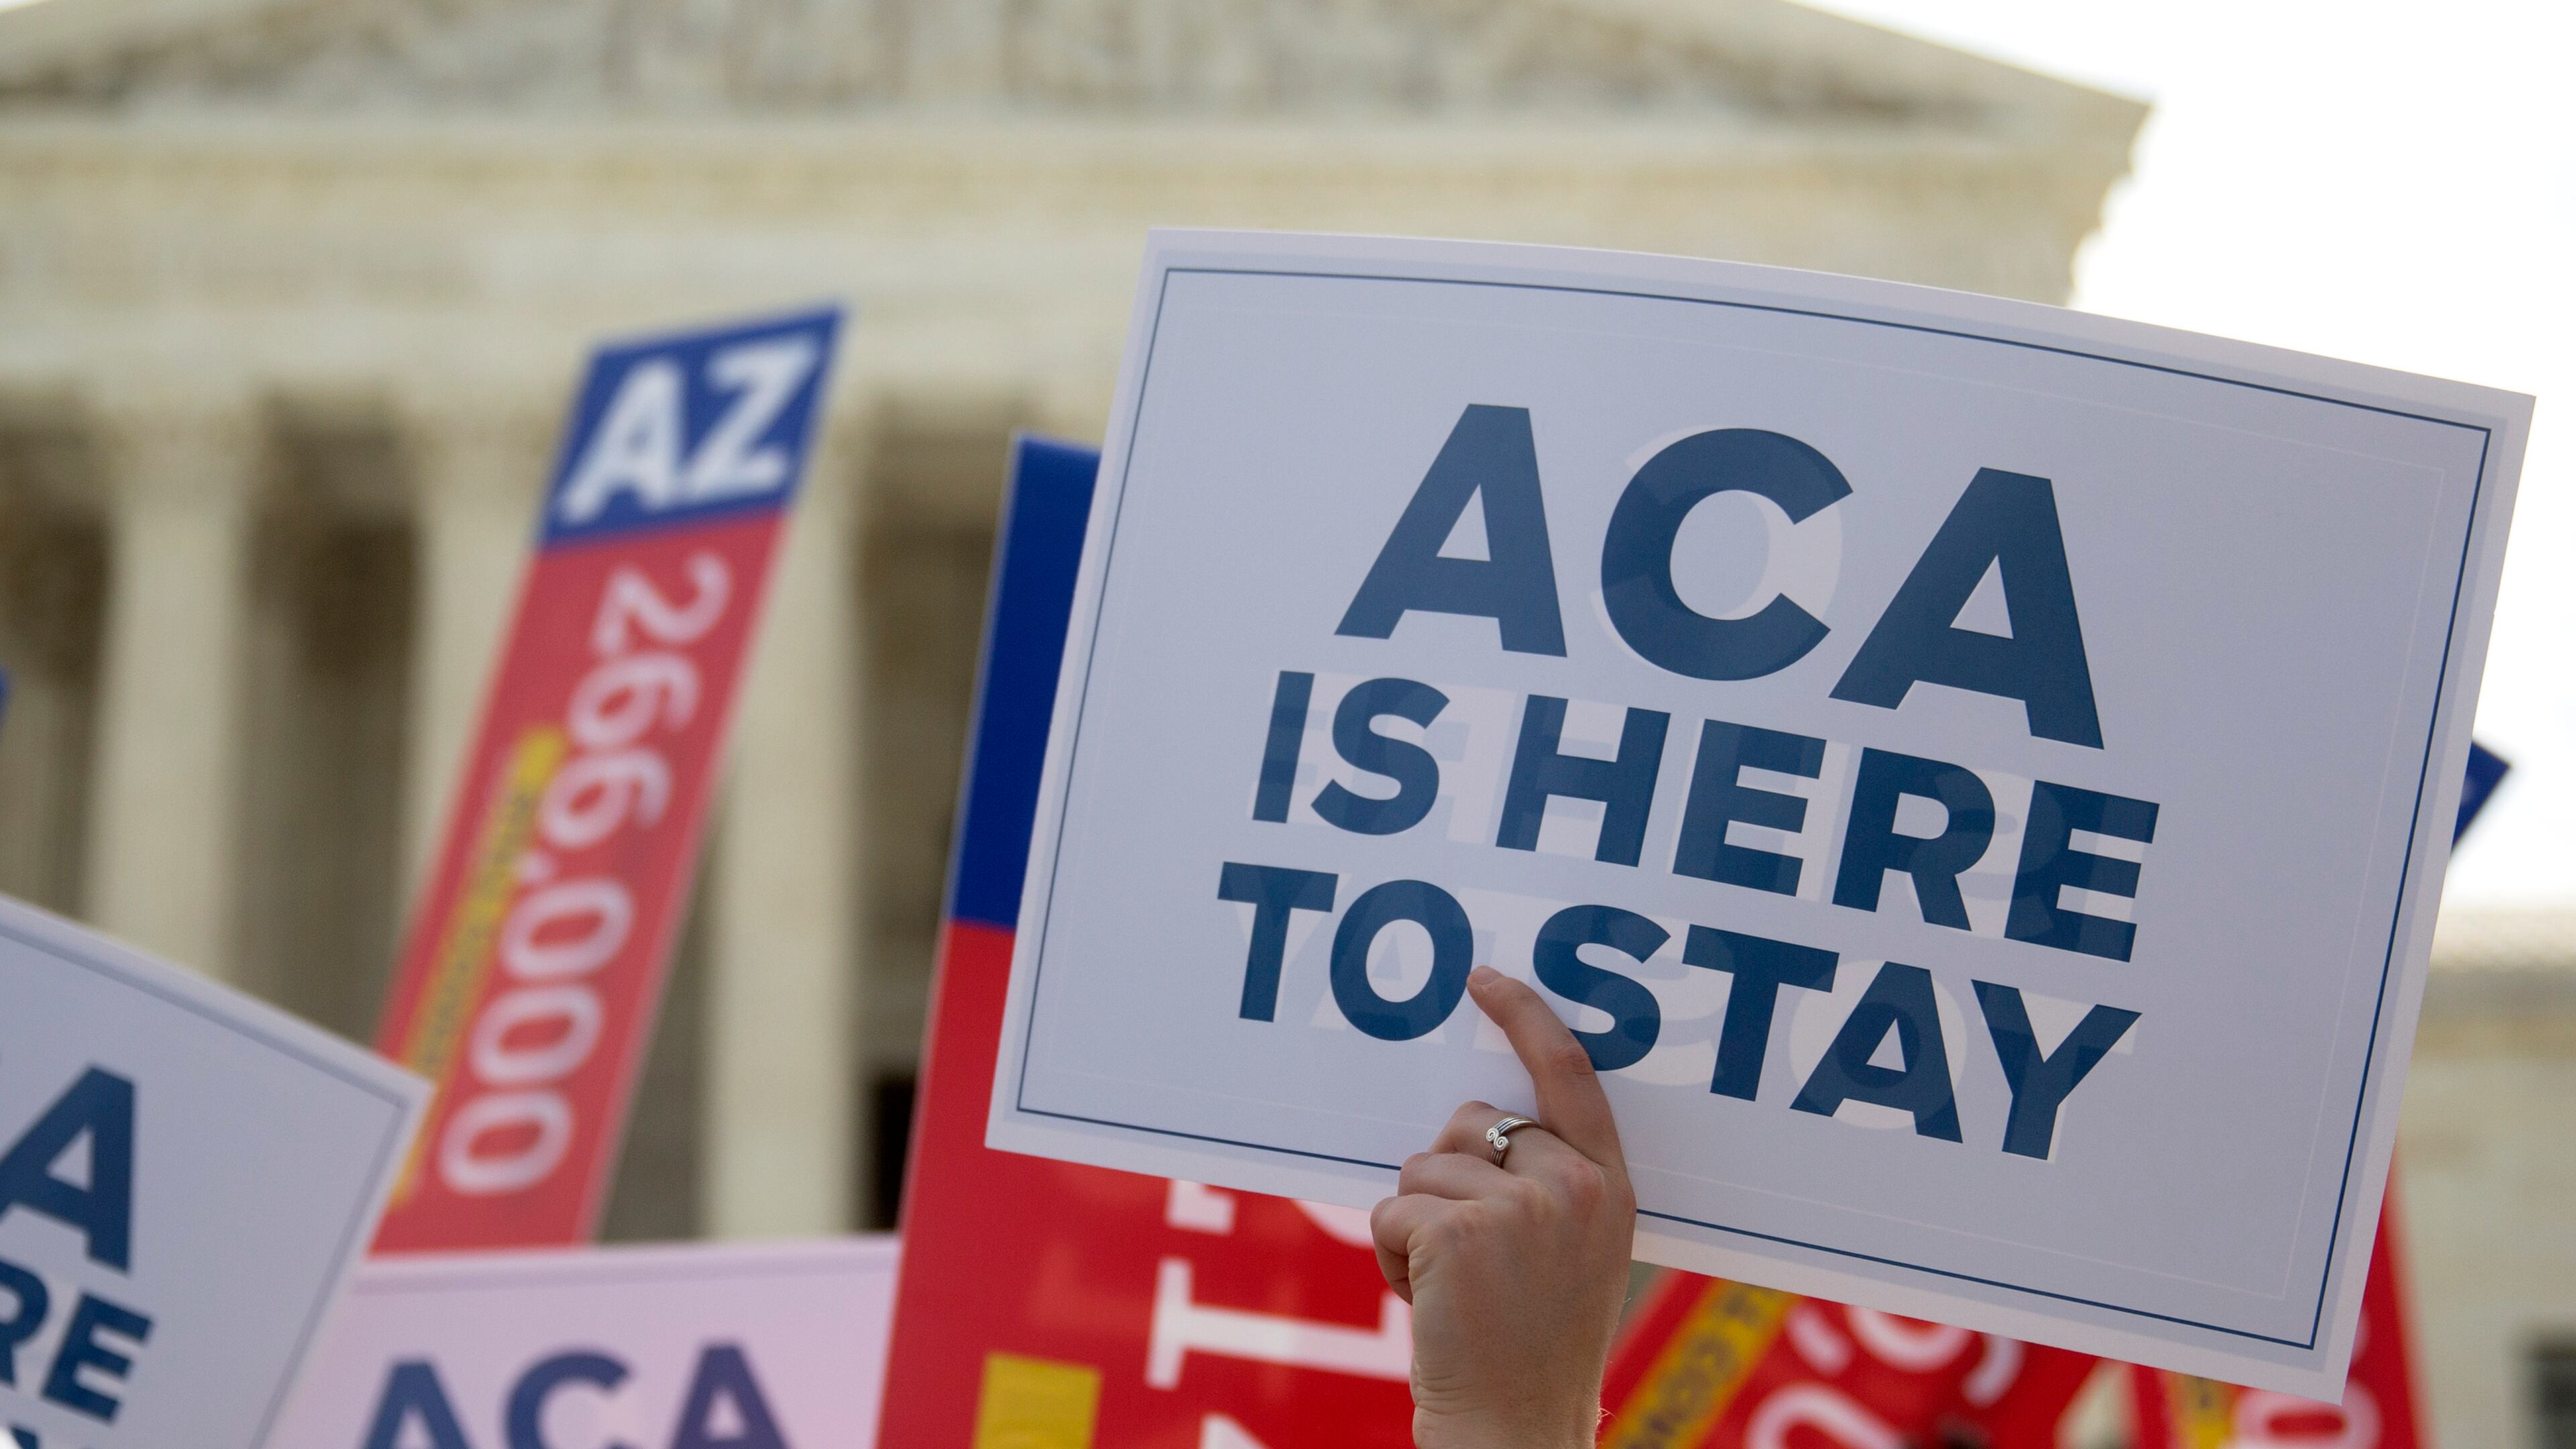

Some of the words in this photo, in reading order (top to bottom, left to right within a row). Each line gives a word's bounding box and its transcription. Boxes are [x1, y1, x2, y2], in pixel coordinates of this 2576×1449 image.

[559, 335, 818, 523] AZ
[1334, 403, 2104, 749] ACA
[436, 553, 733, 1194] 266,000
[1252, 670, 1450, 836] IS
[1495, 694, 2159, 963] HERE
[1217, 861, 1474, 1042] TO
[1532, 904, 2143, 1161] STAY
[361, 1342, 792, 1449] ACA
